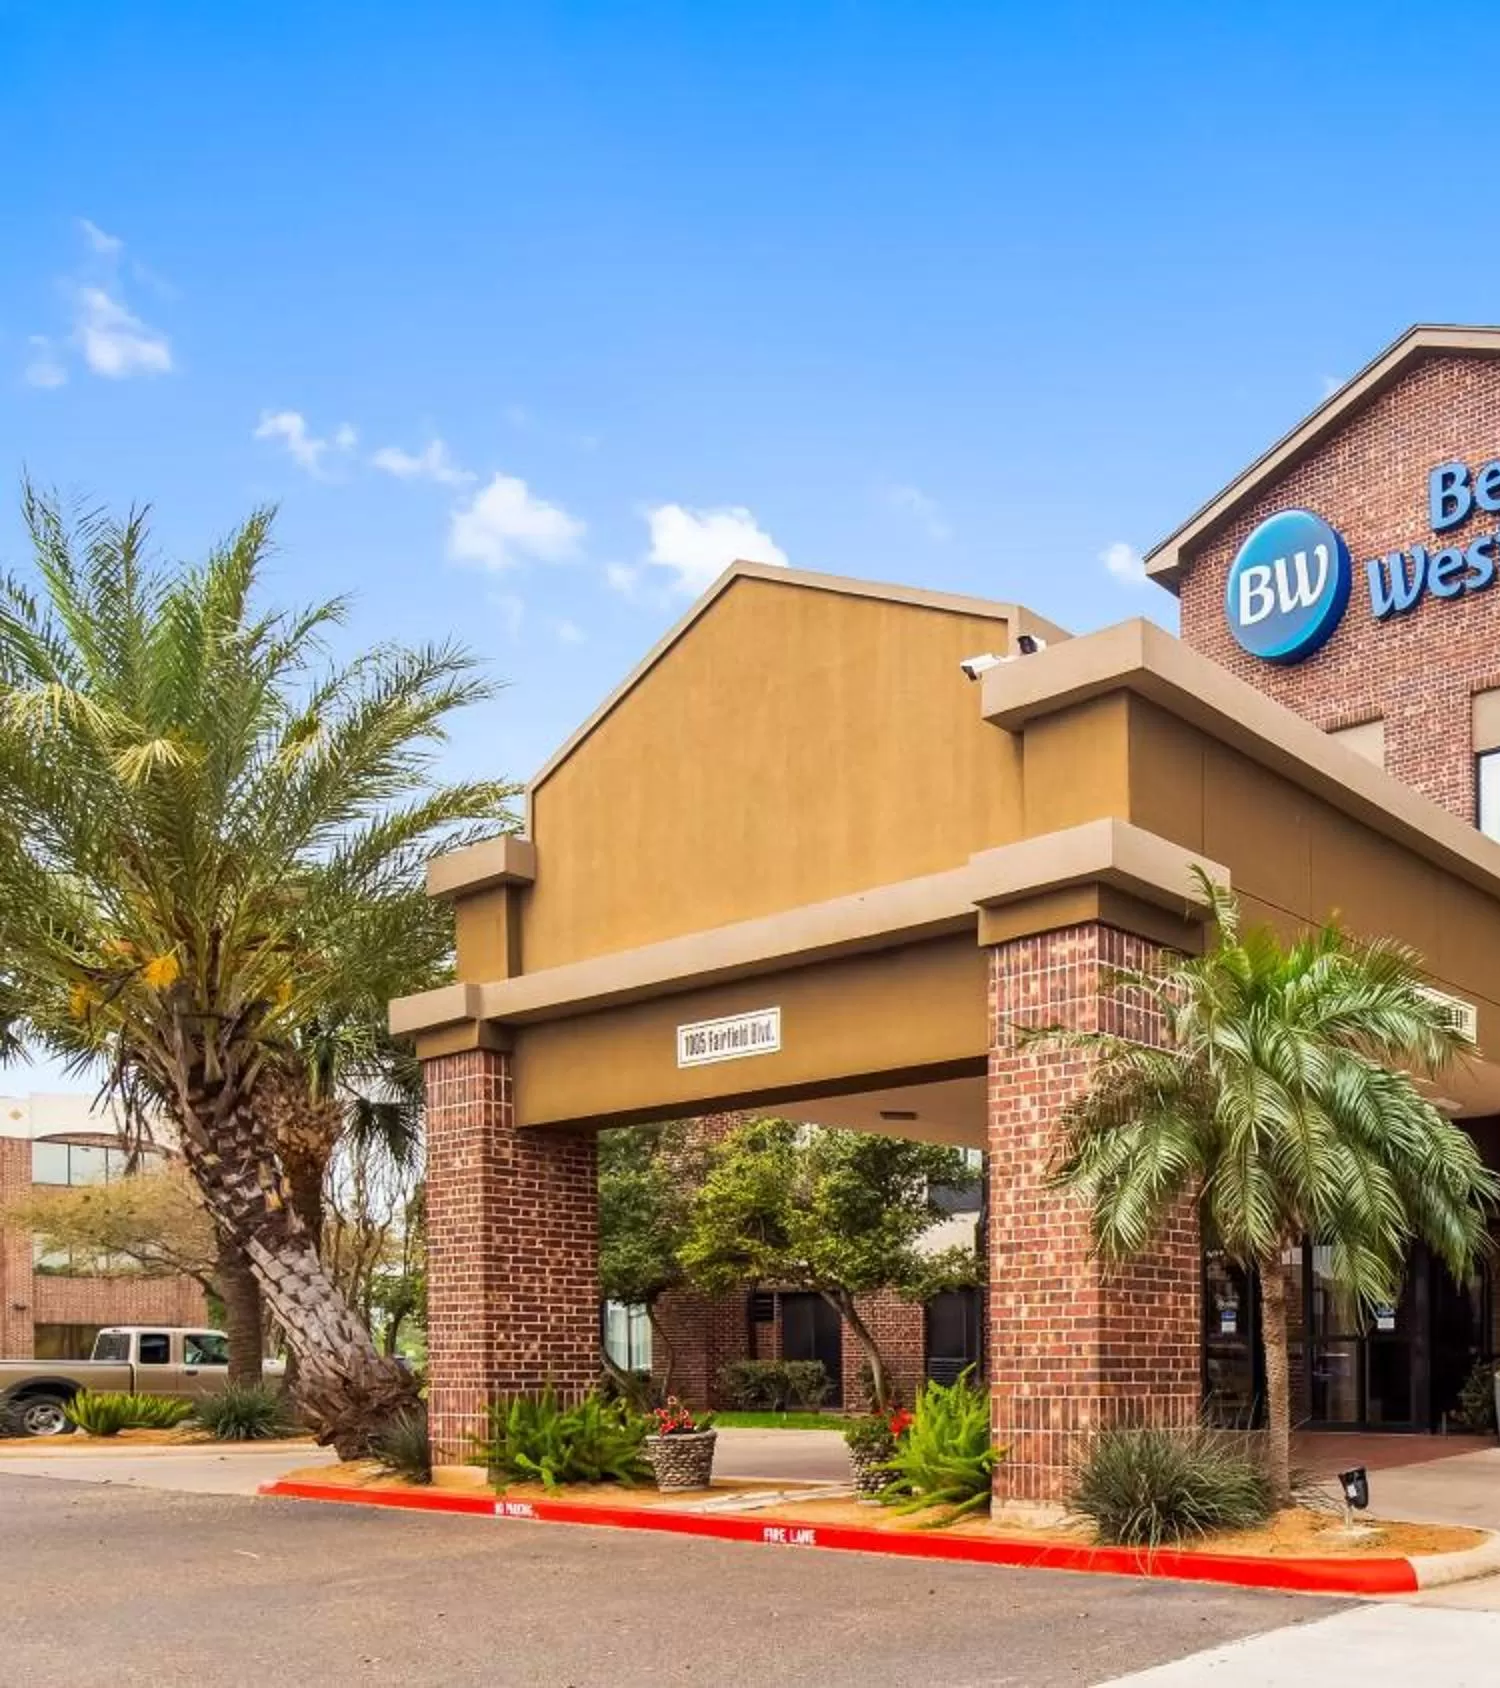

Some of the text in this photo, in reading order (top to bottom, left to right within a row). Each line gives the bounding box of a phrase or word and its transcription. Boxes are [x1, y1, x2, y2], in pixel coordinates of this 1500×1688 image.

[1239, 544, 1328, 625] BW
[708, 1023, 749, 1053] Fairfield
[763, 1526, 817, 1545] FIRE LANE
